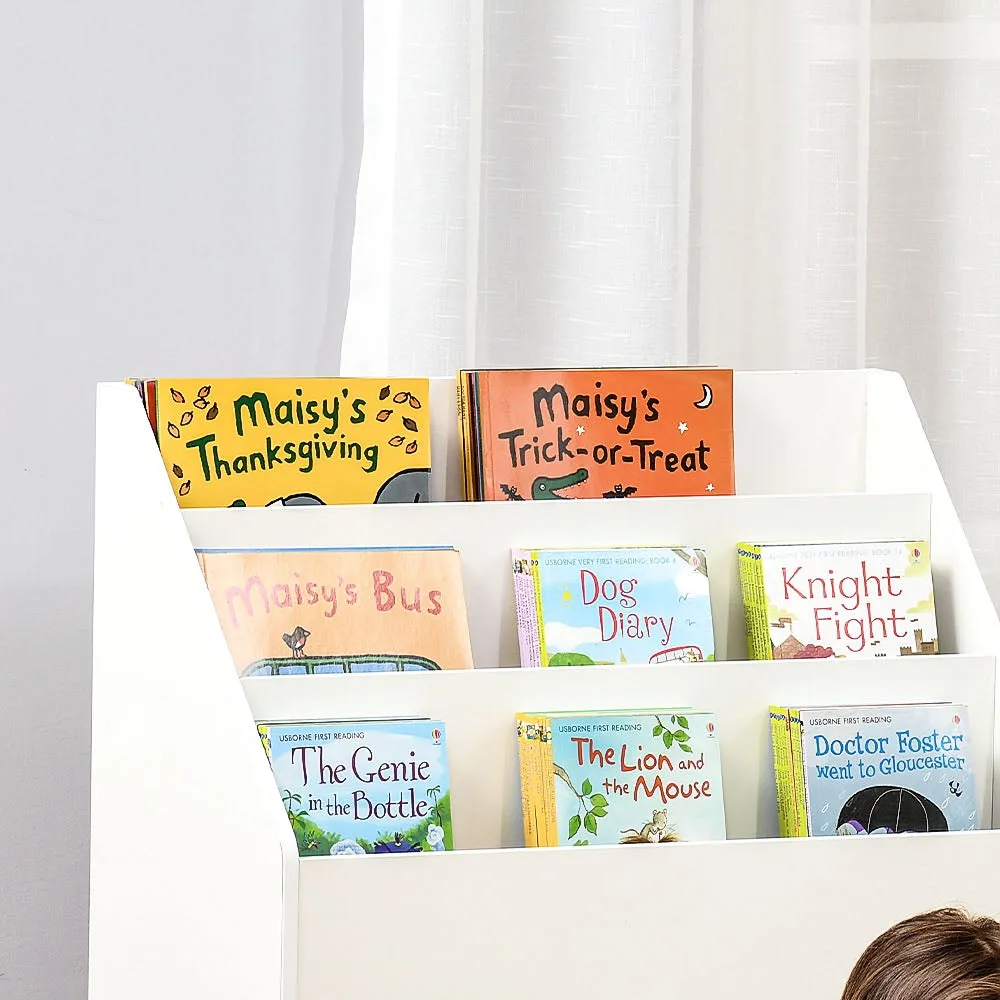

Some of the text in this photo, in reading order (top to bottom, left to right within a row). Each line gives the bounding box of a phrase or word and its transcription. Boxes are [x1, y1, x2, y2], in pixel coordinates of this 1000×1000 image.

[233, 388, 367, 436] Maisy's
[533, 382, 660, 434] Maisy's
[186, 433, 379, 481] Thanksgiving
[498, 427, 710, 472] Trick-or-Treat
[544, 558, 577, 566] USBORNE
[578, 558, 594, 566] VERY
[596, 557, 613, 565] FIRST
[225, 570, 442, 629] Maisy's Bus
[580, 569, 638, 608] Dog
[781, 561, 903, 611] Knight
[599, 606, 675, 646] Diary
[813, 602, 908, 652] Fight
[279, 731, 365, 742] USBORNE FIRST READING
[558, 723, 642, 733] USBORNE FIRST READING
[808, 715, 892, 726] USBORNE FIRST READING
[571, 737, 704, 773] The Lion and
[813, 729, 963, 757] Doctor Foster
[291, 746, 431, 786] The Genie
[815, 753, 965, 781] went to Gloucester
[308, 787, 428, 821] in the Bottle
[602, 775, 712, 804] the Mouse
